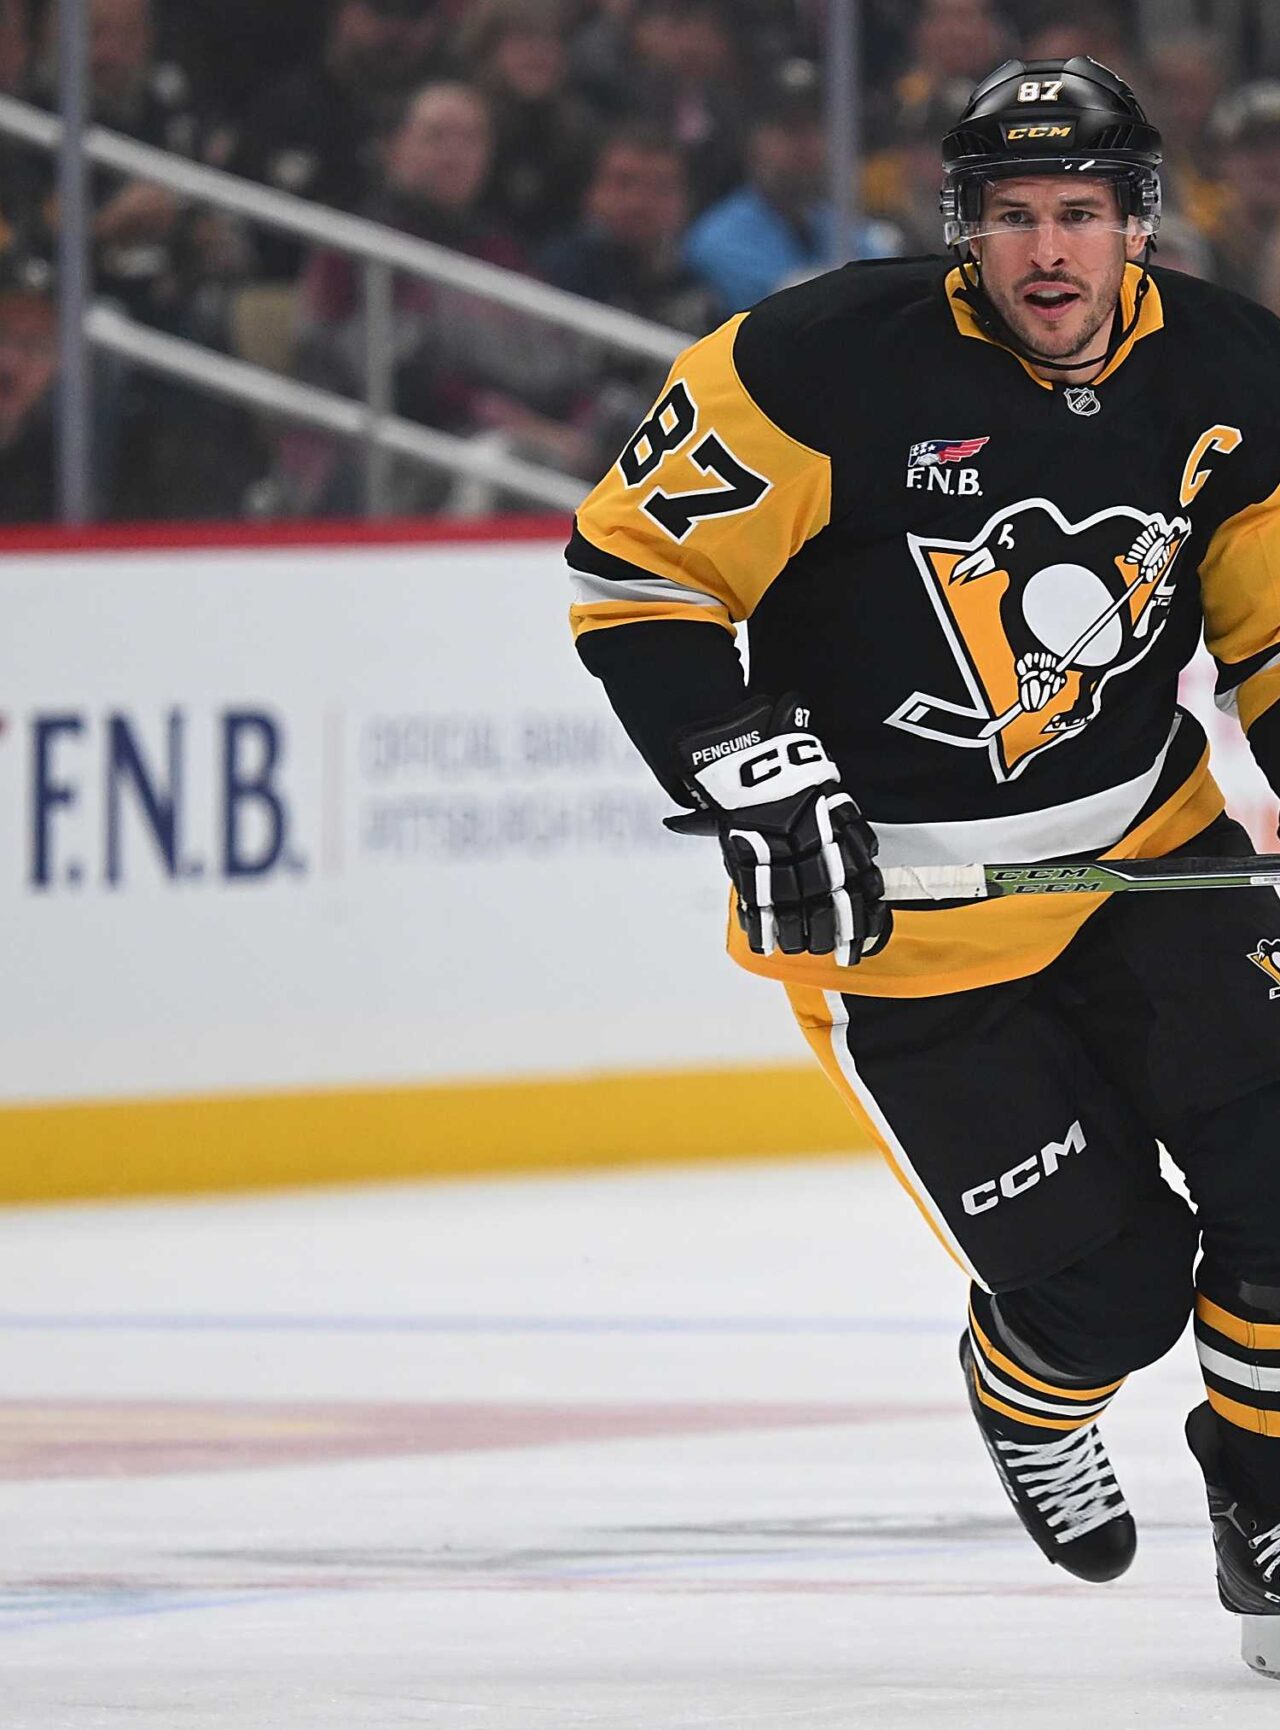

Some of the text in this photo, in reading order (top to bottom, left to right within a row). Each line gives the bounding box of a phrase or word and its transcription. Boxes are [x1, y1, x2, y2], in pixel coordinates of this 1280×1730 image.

[1017, 80, 1065, 103] 87
[1007, 126, 1072, 140] CCM
[1075, 395, 1091, 410] NHL
[615, 378, 776, 546] 87
[1179, 424, 1244, 508] C
[906, 465, 984, 497] F.N.B.
[794, 707, 811, 728] 87
[691, 730, 761, 766] PENGUINS
[739, 740, 823, 788] CC
[25, 703, 308, 890] F.N.B.
[993, 867, 1090, 882] CCM
[1013, 881, 1103, 895] CCM
[961, 1120, 1087, 1216] CCM
